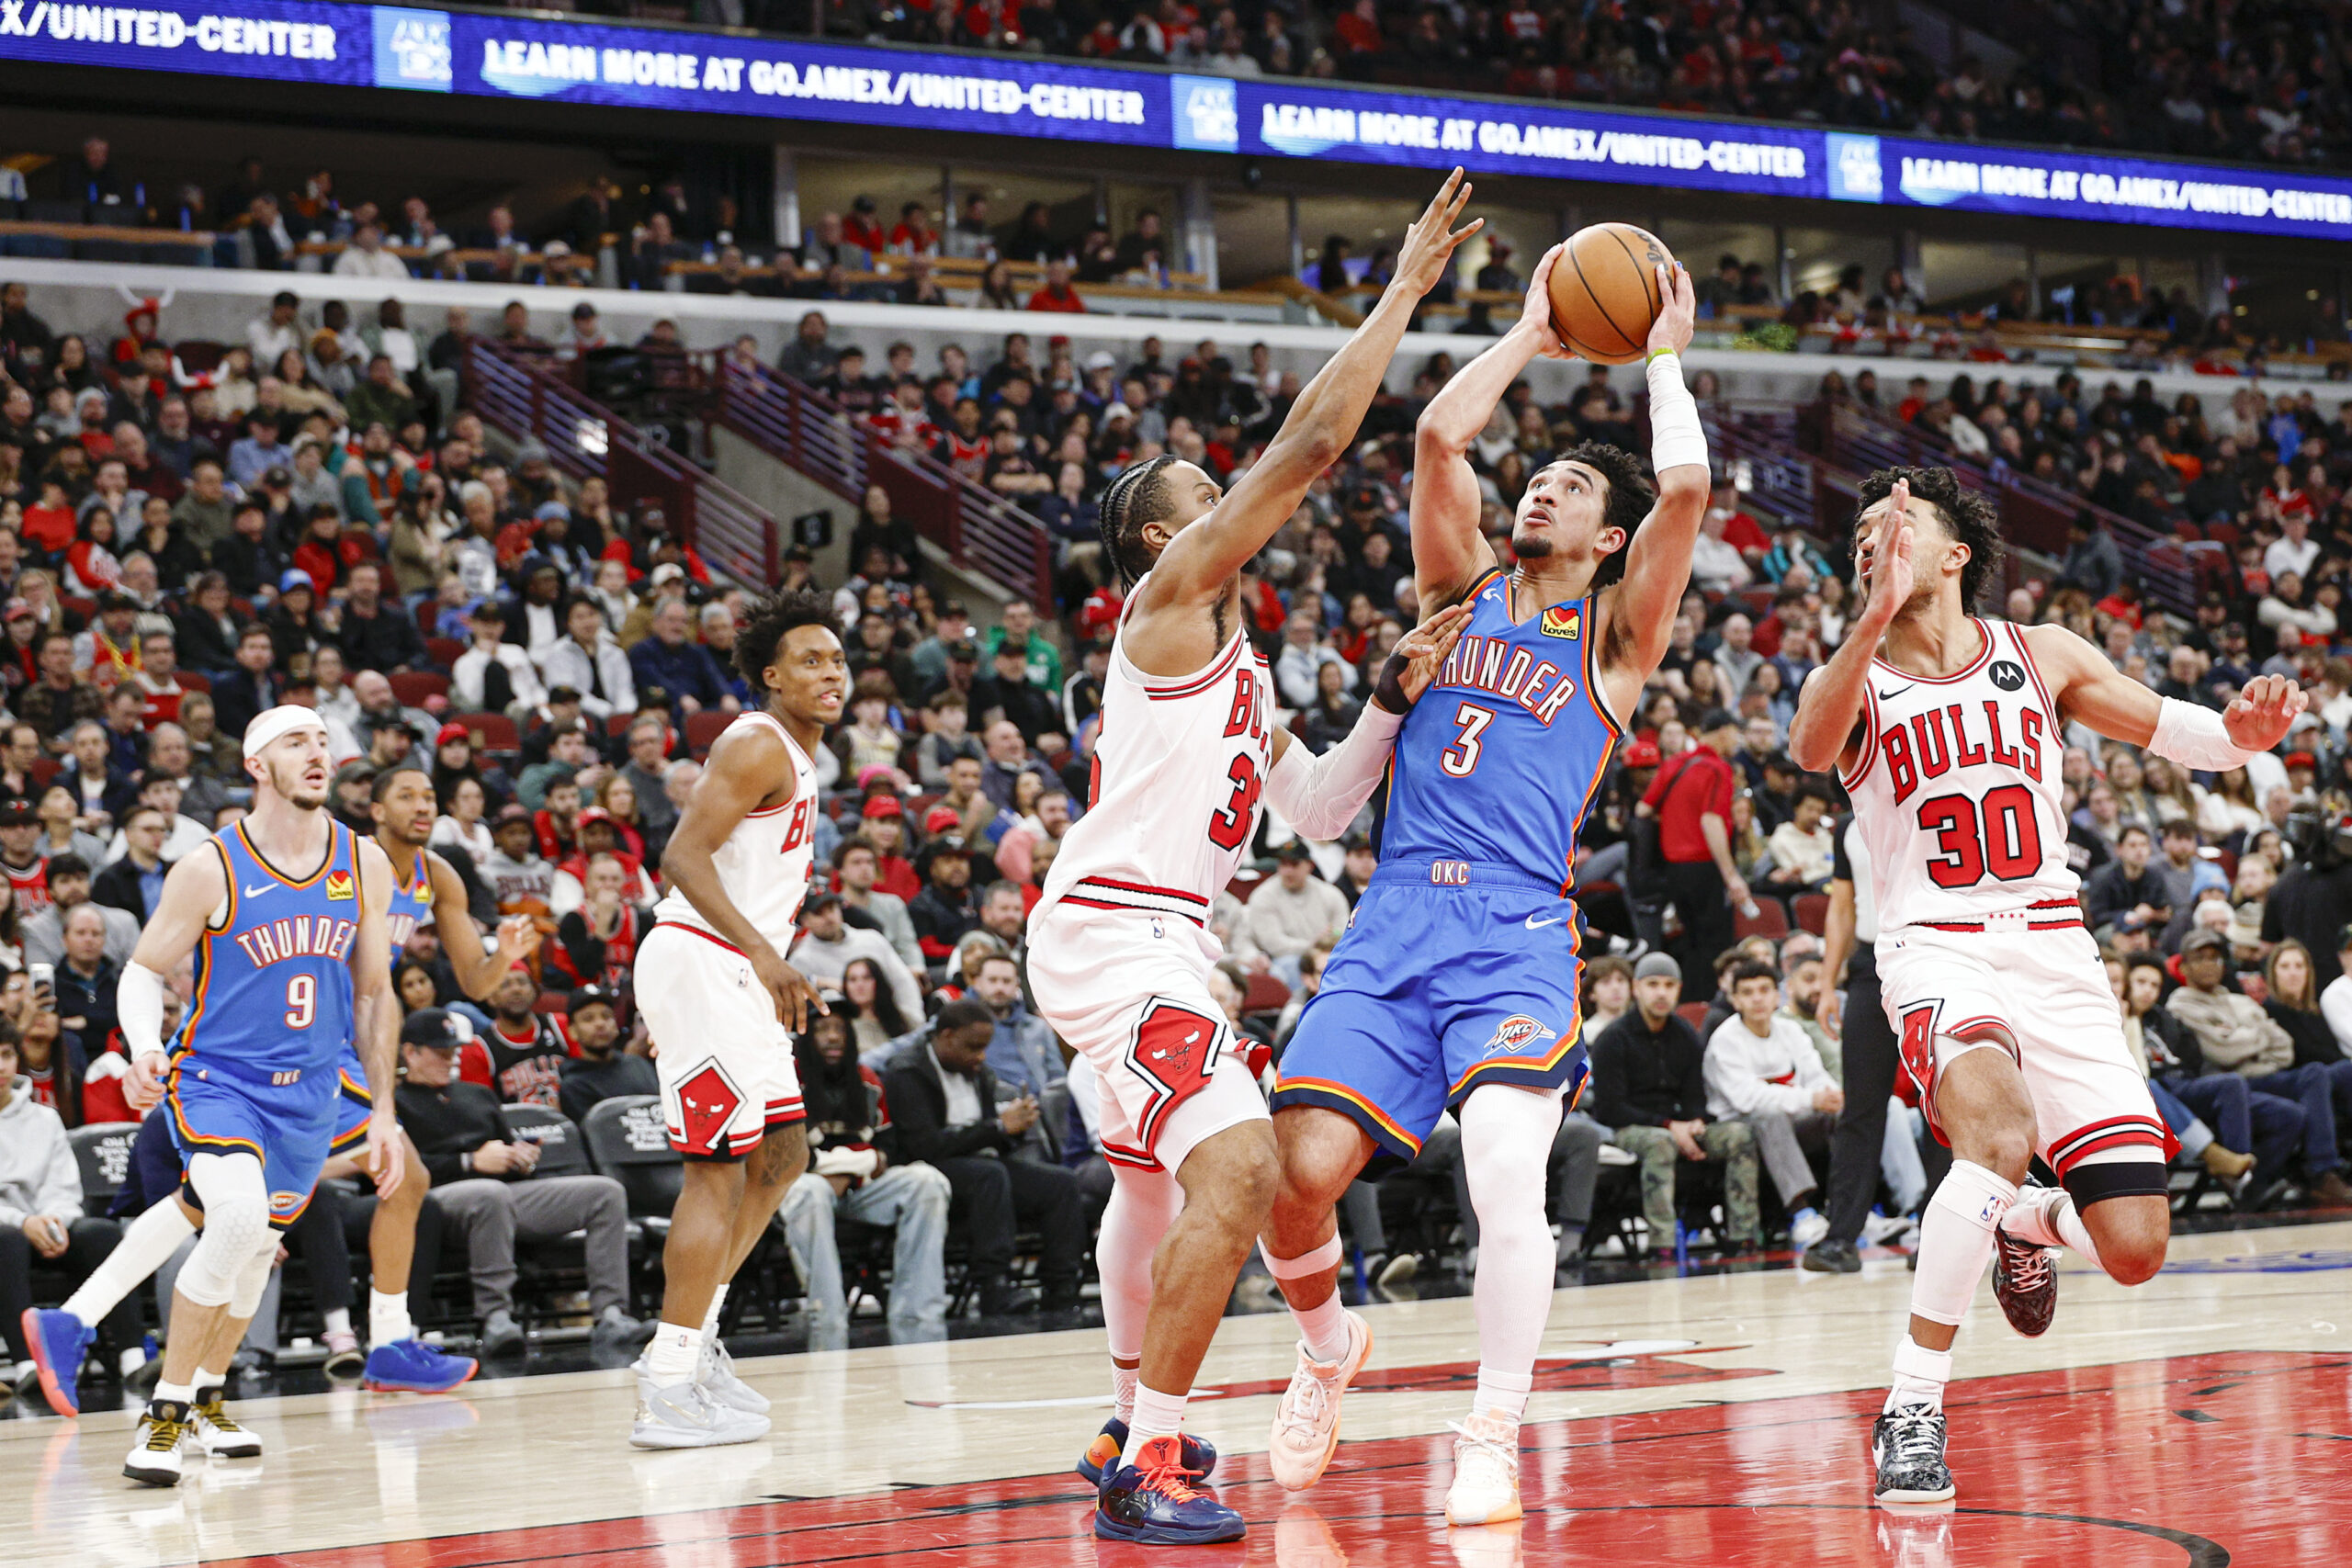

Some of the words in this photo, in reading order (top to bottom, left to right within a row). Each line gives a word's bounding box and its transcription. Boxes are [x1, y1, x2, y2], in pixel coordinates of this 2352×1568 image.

[484, 39, 597, 81] LEARN
[602, 48, 699, 89] MORE
[702, 56, 744, 92] AT
[1262, 103, 1356, 142] LEARN
[1358, 110, 1440, 149] MORE
[1440, 118, 1476, 151] AT
[1901, 156, 1980, 194] LEARN
[1981, 164, 2049, 199] MORE
[2049, 170, 2079, 201] AT
[1441, 701, 1497, 778] 3
[1880, 700, 2042, 807] BULLS
[1917, 784, 2042, 889] 30
[1430, 860, 1470, 886] OKC
[284, 974, 317, 1030] 9
[271, 1068, 301, 1087] OKC
